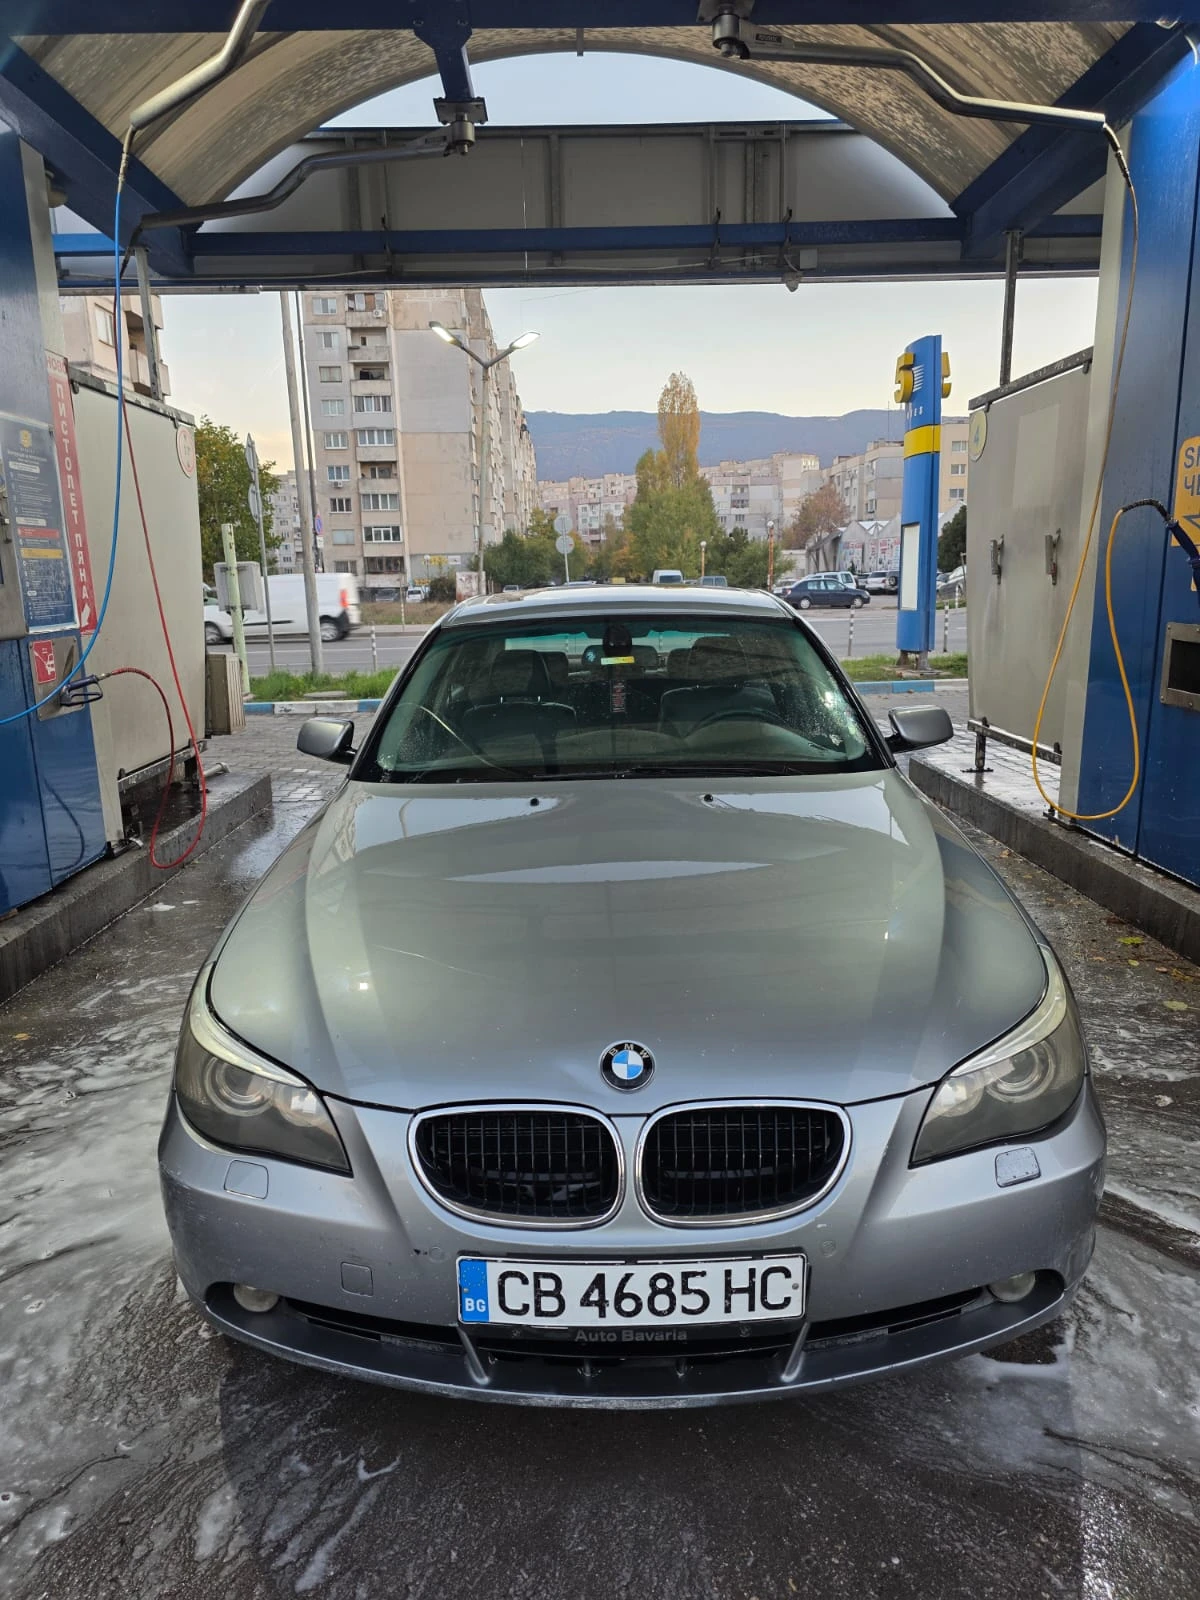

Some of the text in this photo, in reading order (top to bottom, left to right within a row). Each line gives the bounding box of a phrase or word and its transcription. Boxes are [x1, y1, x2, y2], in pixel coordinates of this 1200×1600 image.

[1184, 446, 1200, 468] S
[56, 383, 89, 599] ПИСТОЛЕТ ПЯНА
[608, 1043, 650, 1059] BMW
[498, 1266, 792, 1318] CB 4685 HC
[465, 1297, 486, 1312] BG
[574, 1328, 687, 1342] Auto Bavaria
